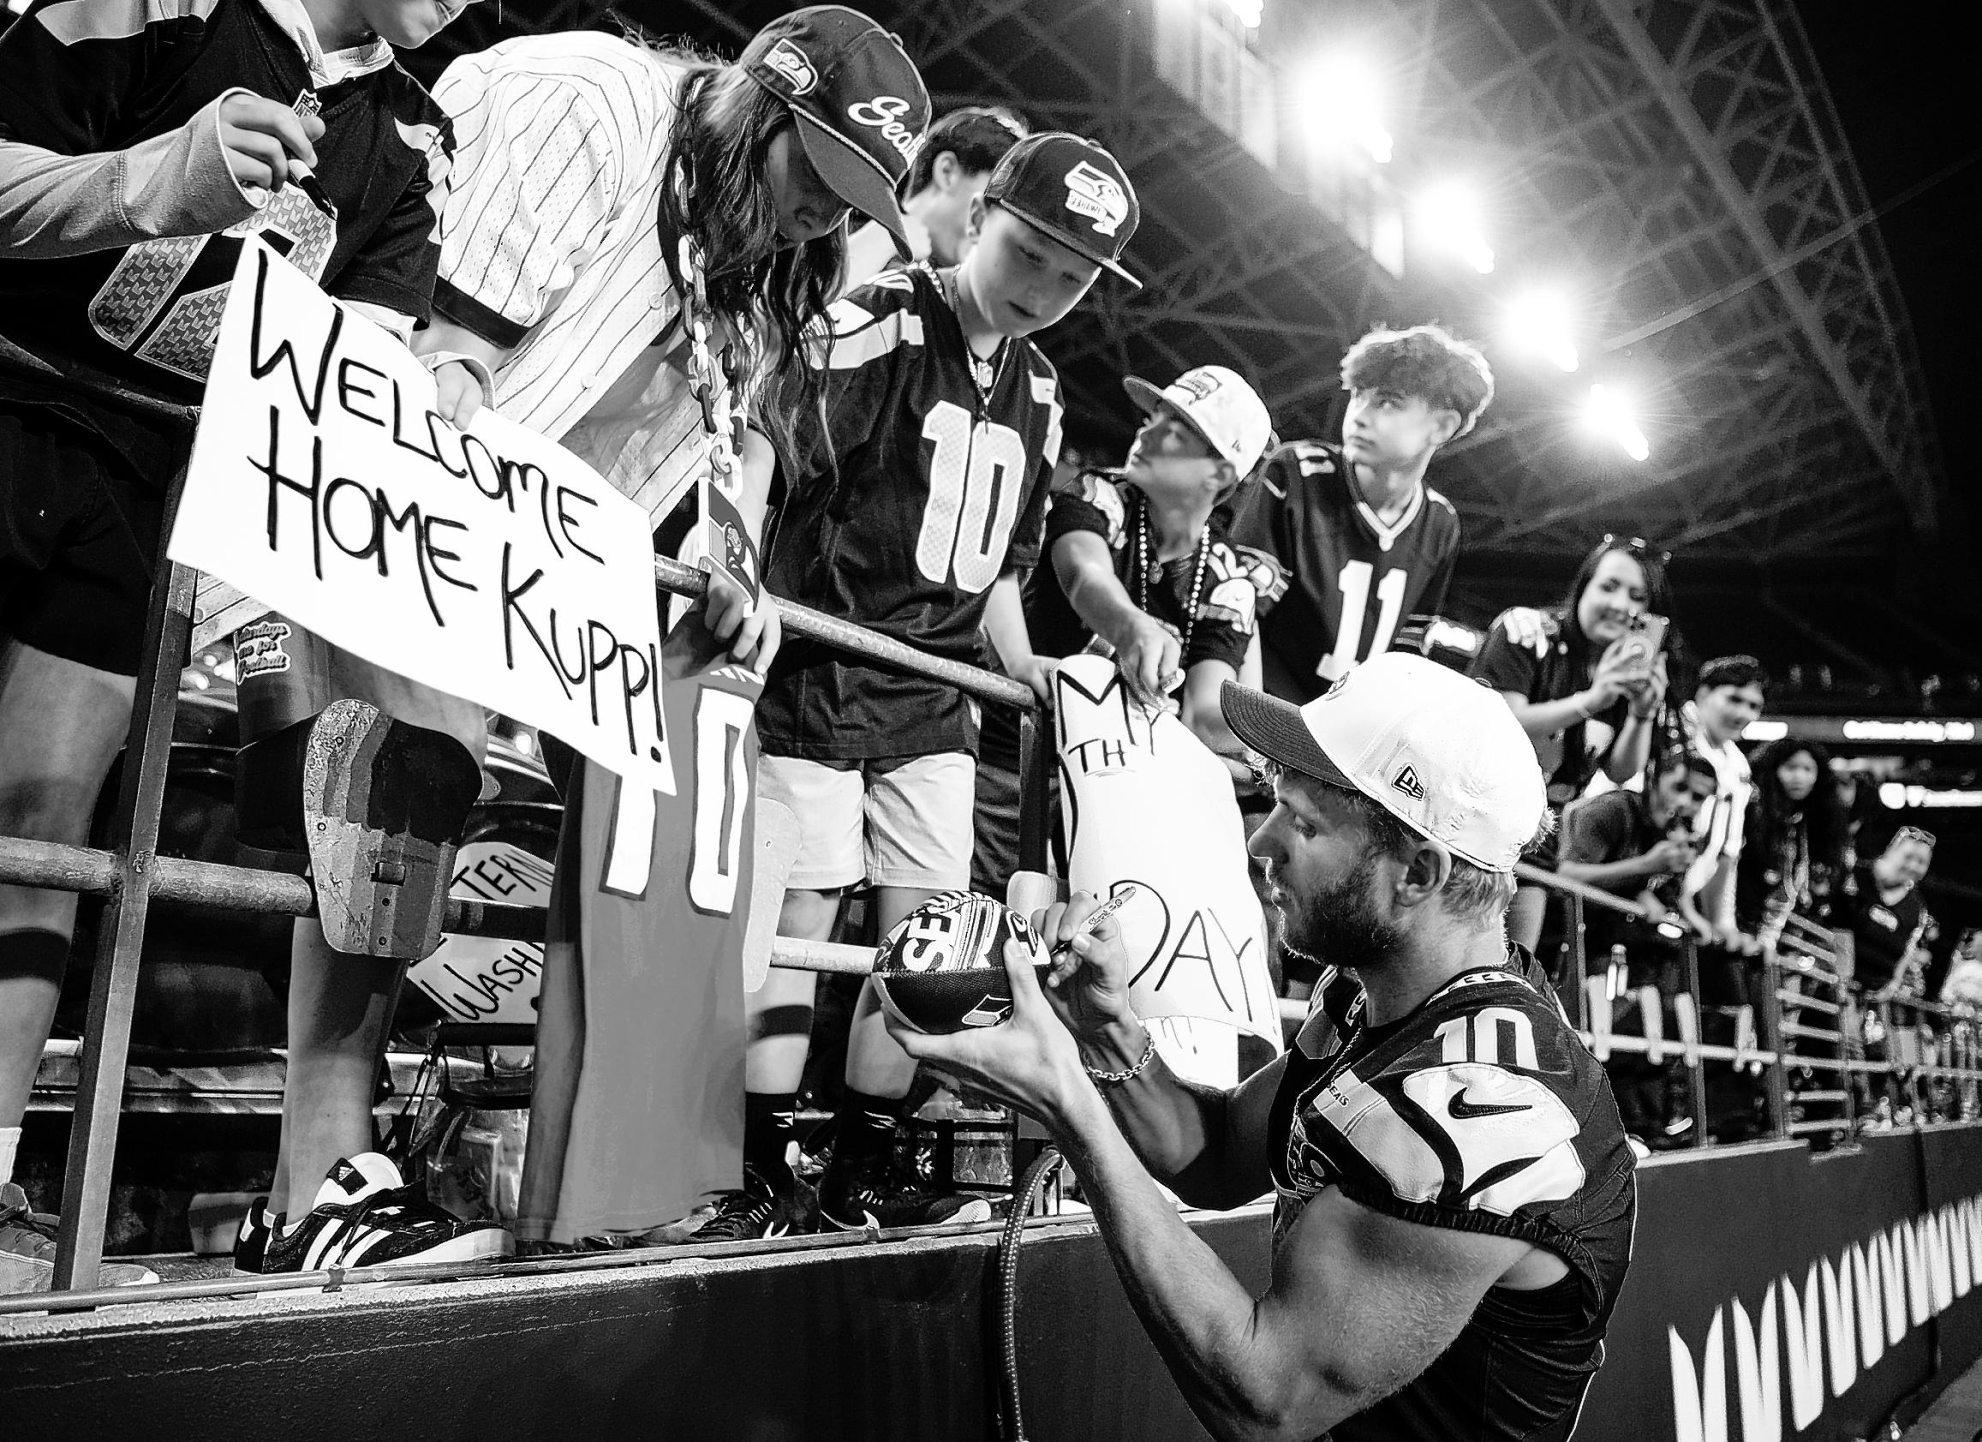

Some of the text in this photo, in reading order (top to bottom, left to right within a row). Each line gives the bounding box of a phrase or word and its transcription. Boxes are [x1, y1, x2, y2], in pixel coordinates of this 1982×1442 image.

[915, 399, 1027, 594] 10
[246, 404, 664, 764] HOME KUPP!
[1316, 559, 1408, 684] 11
[1433, 1006, 1540, 1072] 10
